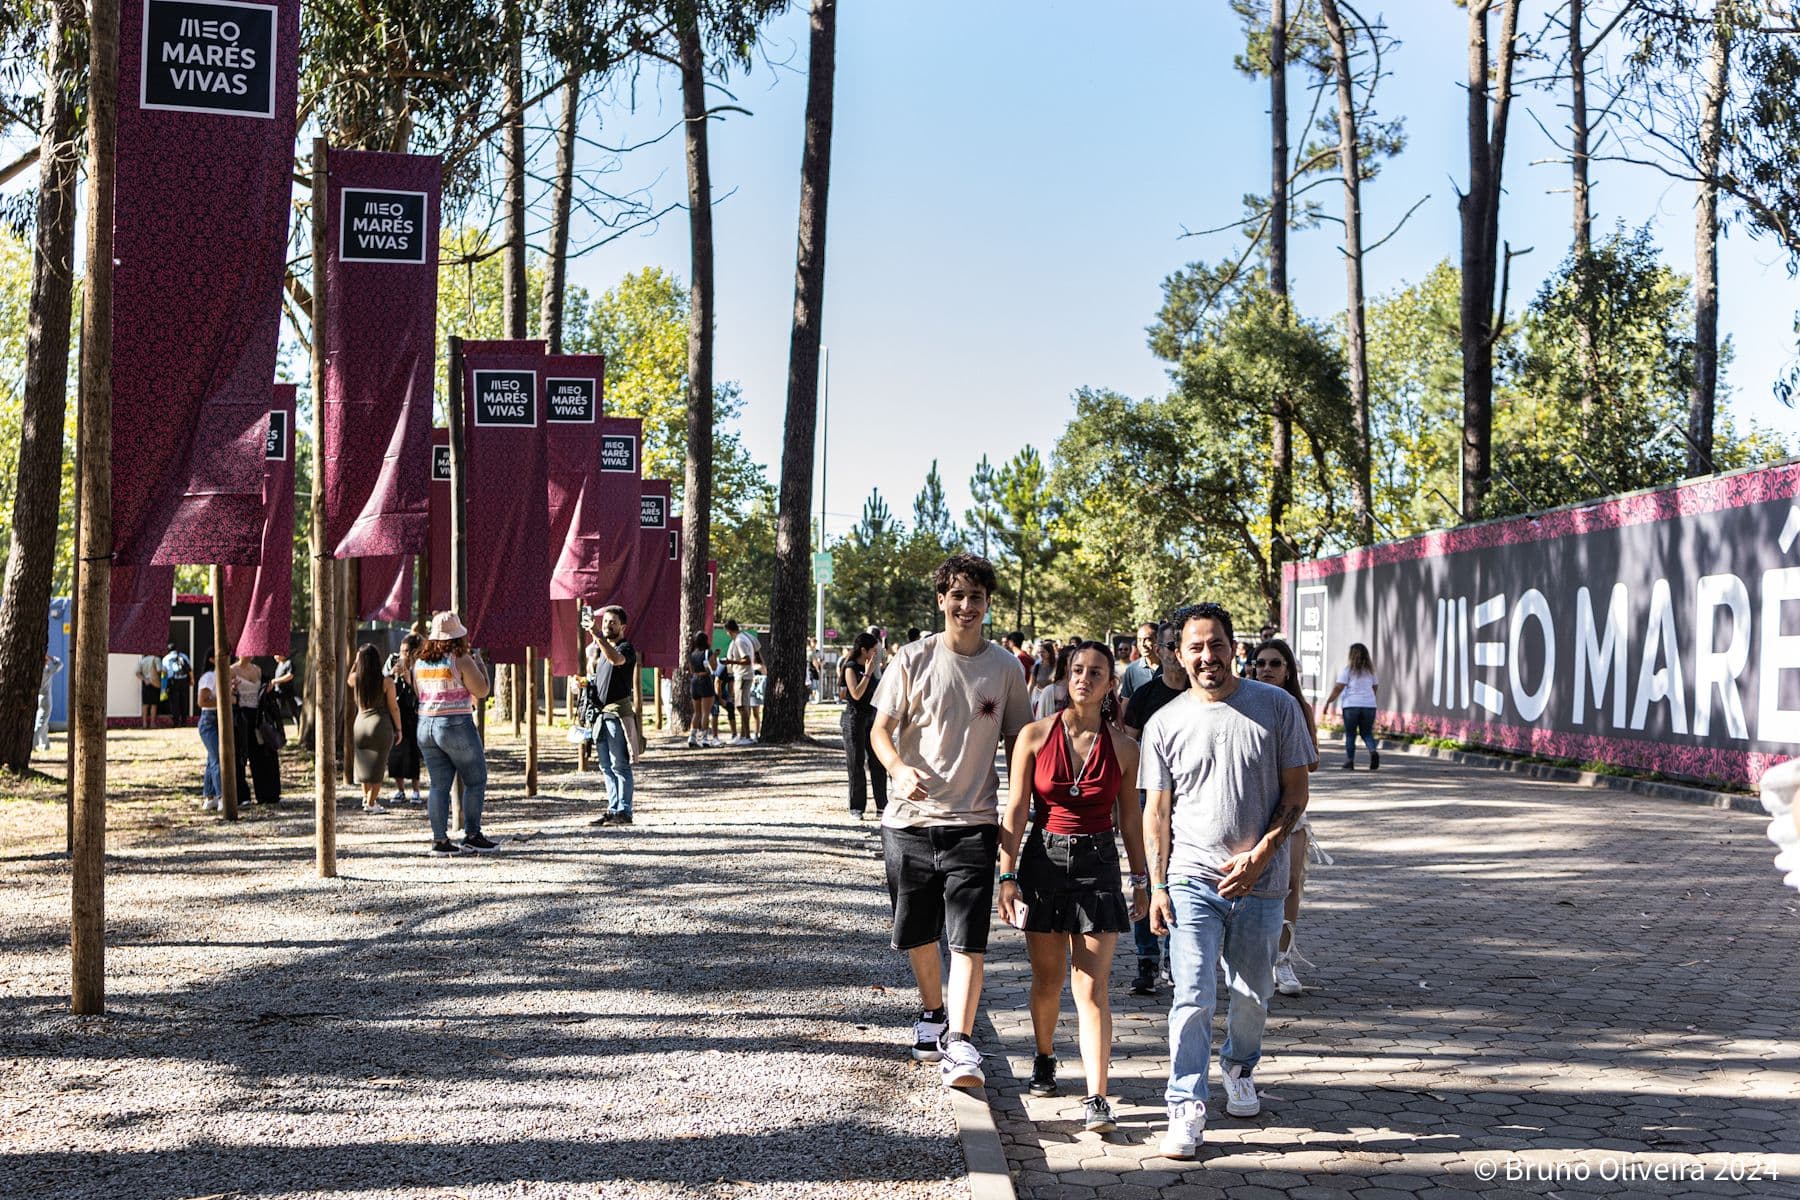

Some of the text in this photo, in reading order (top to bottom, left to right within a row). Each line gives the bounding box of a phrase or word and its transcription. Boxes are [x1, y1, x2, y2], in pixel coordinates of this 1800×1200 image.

[180, 18, 240, 41] MEO
[162, 41, 256, 70] MARÉS
[169, 68, 248, 95] VIVAS
[364, 202, 404, 216] MEO
[353, 216, 414, 234] MARÉS
[358, 234, 409, 250] VIVAS
[490, 380, 520, 391] MEO
[558, 385, 582, 395] MEO
[483, 390, 528, 404] MARÉS
[551, 394, 588, 406] MARÉS
[487, 405, 525, 417] VIVAS
[554, 406, 585, 416] VIVAS
[605, 441, 625, 449] MEO
[602, 458, 628, 466] VIVAS
[641, 508, 661, 516] ARÉS
[1432, 588, 1556, 722] MEO
